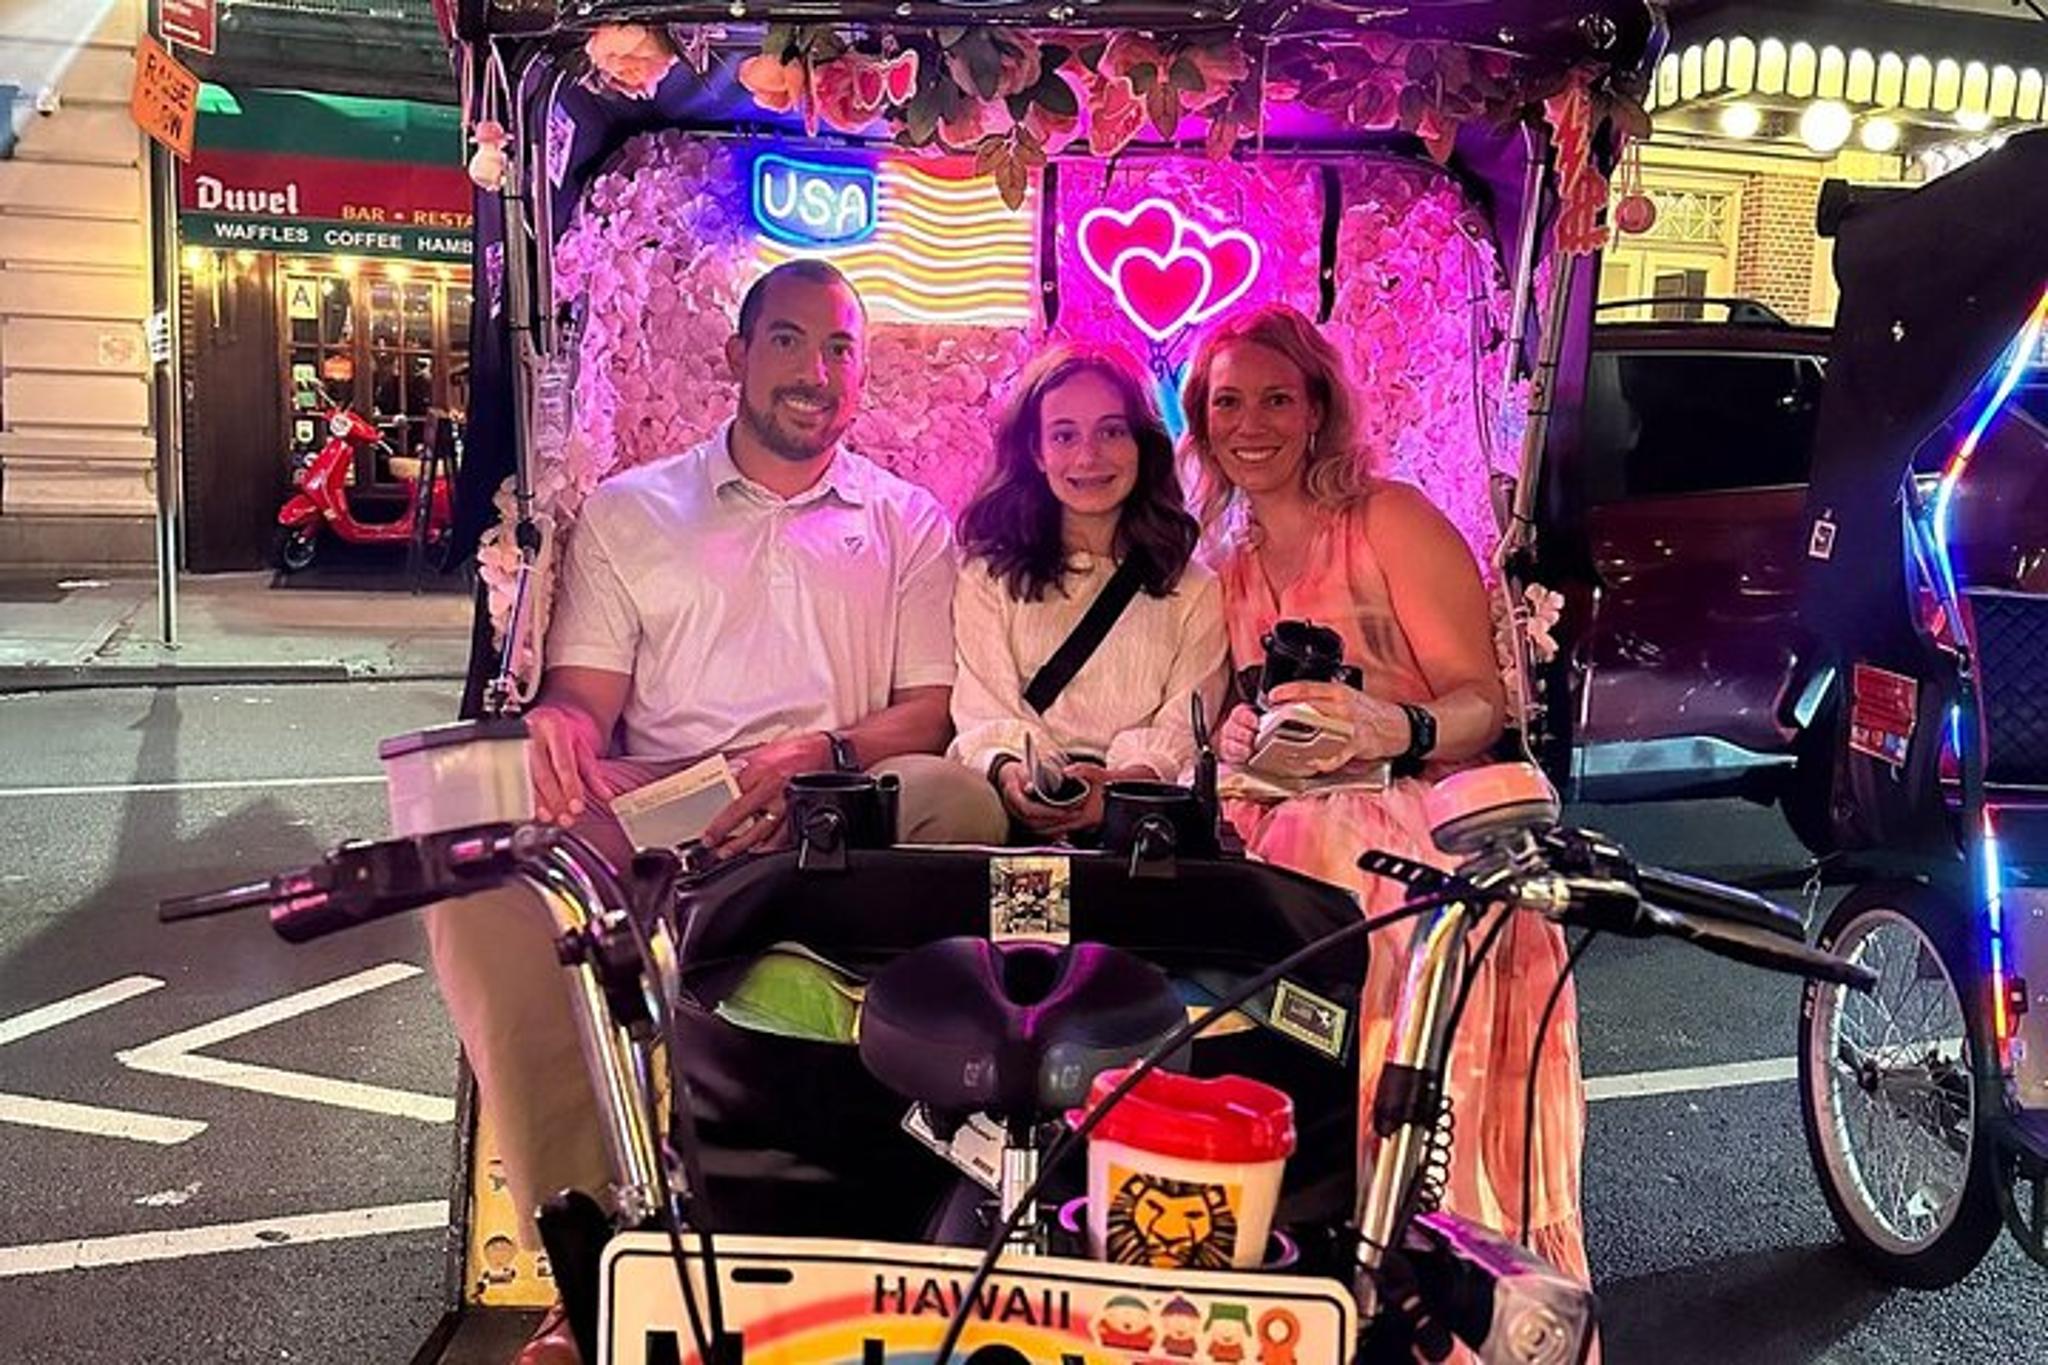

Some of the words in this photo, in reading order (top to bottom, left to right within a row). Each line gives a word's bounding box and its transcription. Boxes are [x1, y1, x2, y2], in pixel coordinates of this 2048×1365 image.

[195, 175, 298, 215] Duvel
[342, 204, 385, 221] BAR
[764, 171, 868, 233] USA
[215, 223, 309, 243] WAFFLES
[324, 229, 402, 249] COFFEE
[417, 237, 473, 254] HAMB
[293, 285, 311, 307] A
[875, 1274, 1070, 1330] HAWAII
